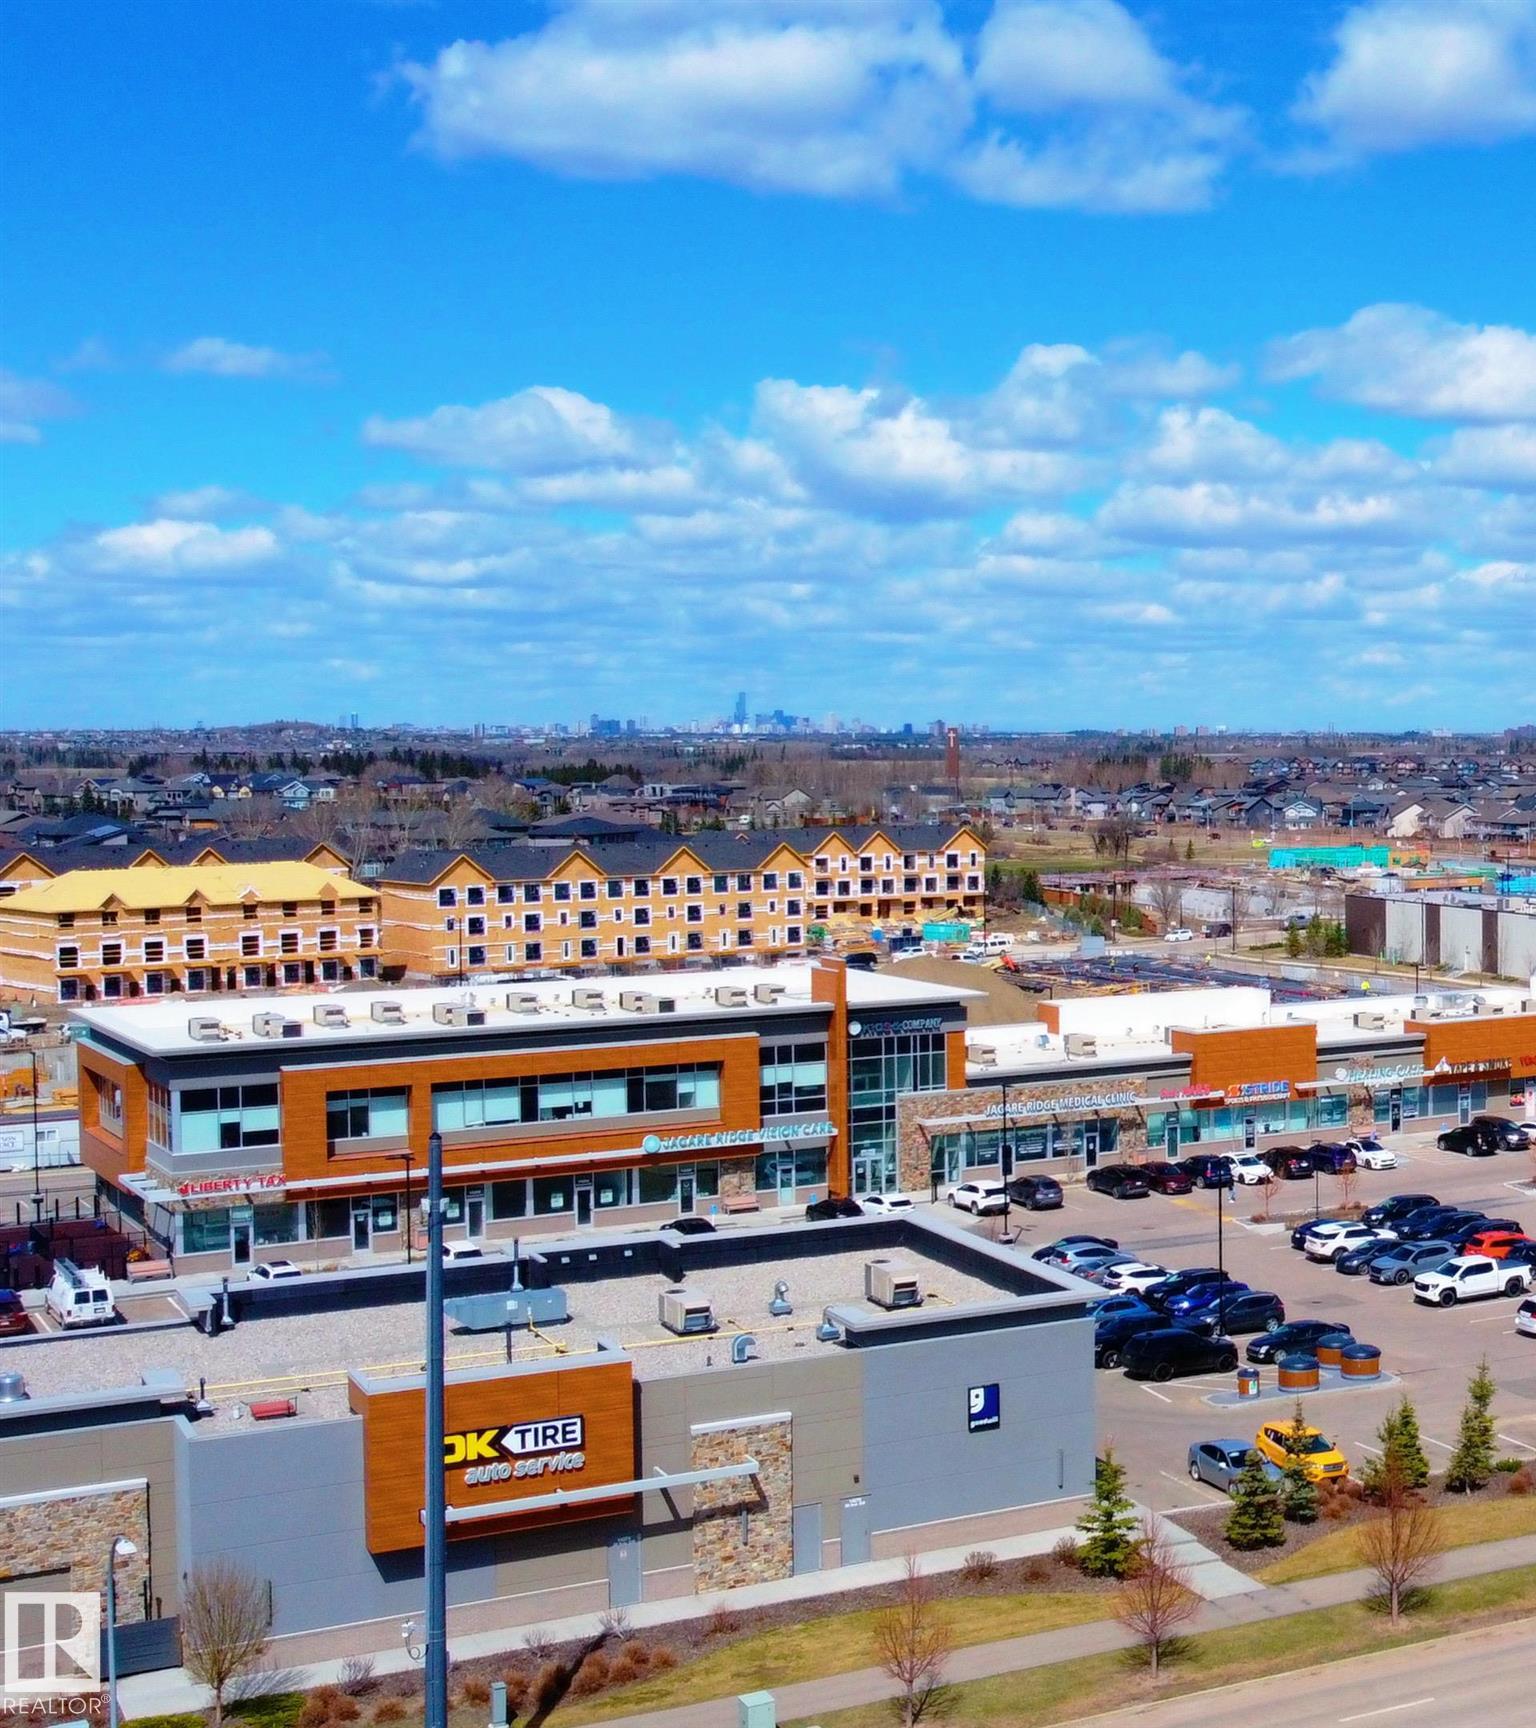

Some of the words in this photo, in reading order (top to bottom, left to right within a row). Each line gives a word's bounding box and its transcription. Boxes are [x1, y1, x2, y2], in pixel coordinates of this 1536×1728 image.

[1243, 1080, 1290, 1095] STRIDE
[985, 1104, 1024, 1117] JAGARE
[1025, 1100, 1057, 1113] RIDGE
[1058, 1094, 1102, 1110] MEDICAL
[1103, 1091, 1137, 1106] CLINIC
[716, 1130, 754, 1144] RIDGE
[758, 1126, 798, 1141] VISION
[803, 1122, 835, 1136] CARE
[190, 1179, 252, 1194] LIBERTY
[258, 1174, 287, 1188] TAX
[515, 1421, 578, 1450] TIRE
[464, 1462, 511, 1485] auto
[513, 1451, 585, 1478] service
